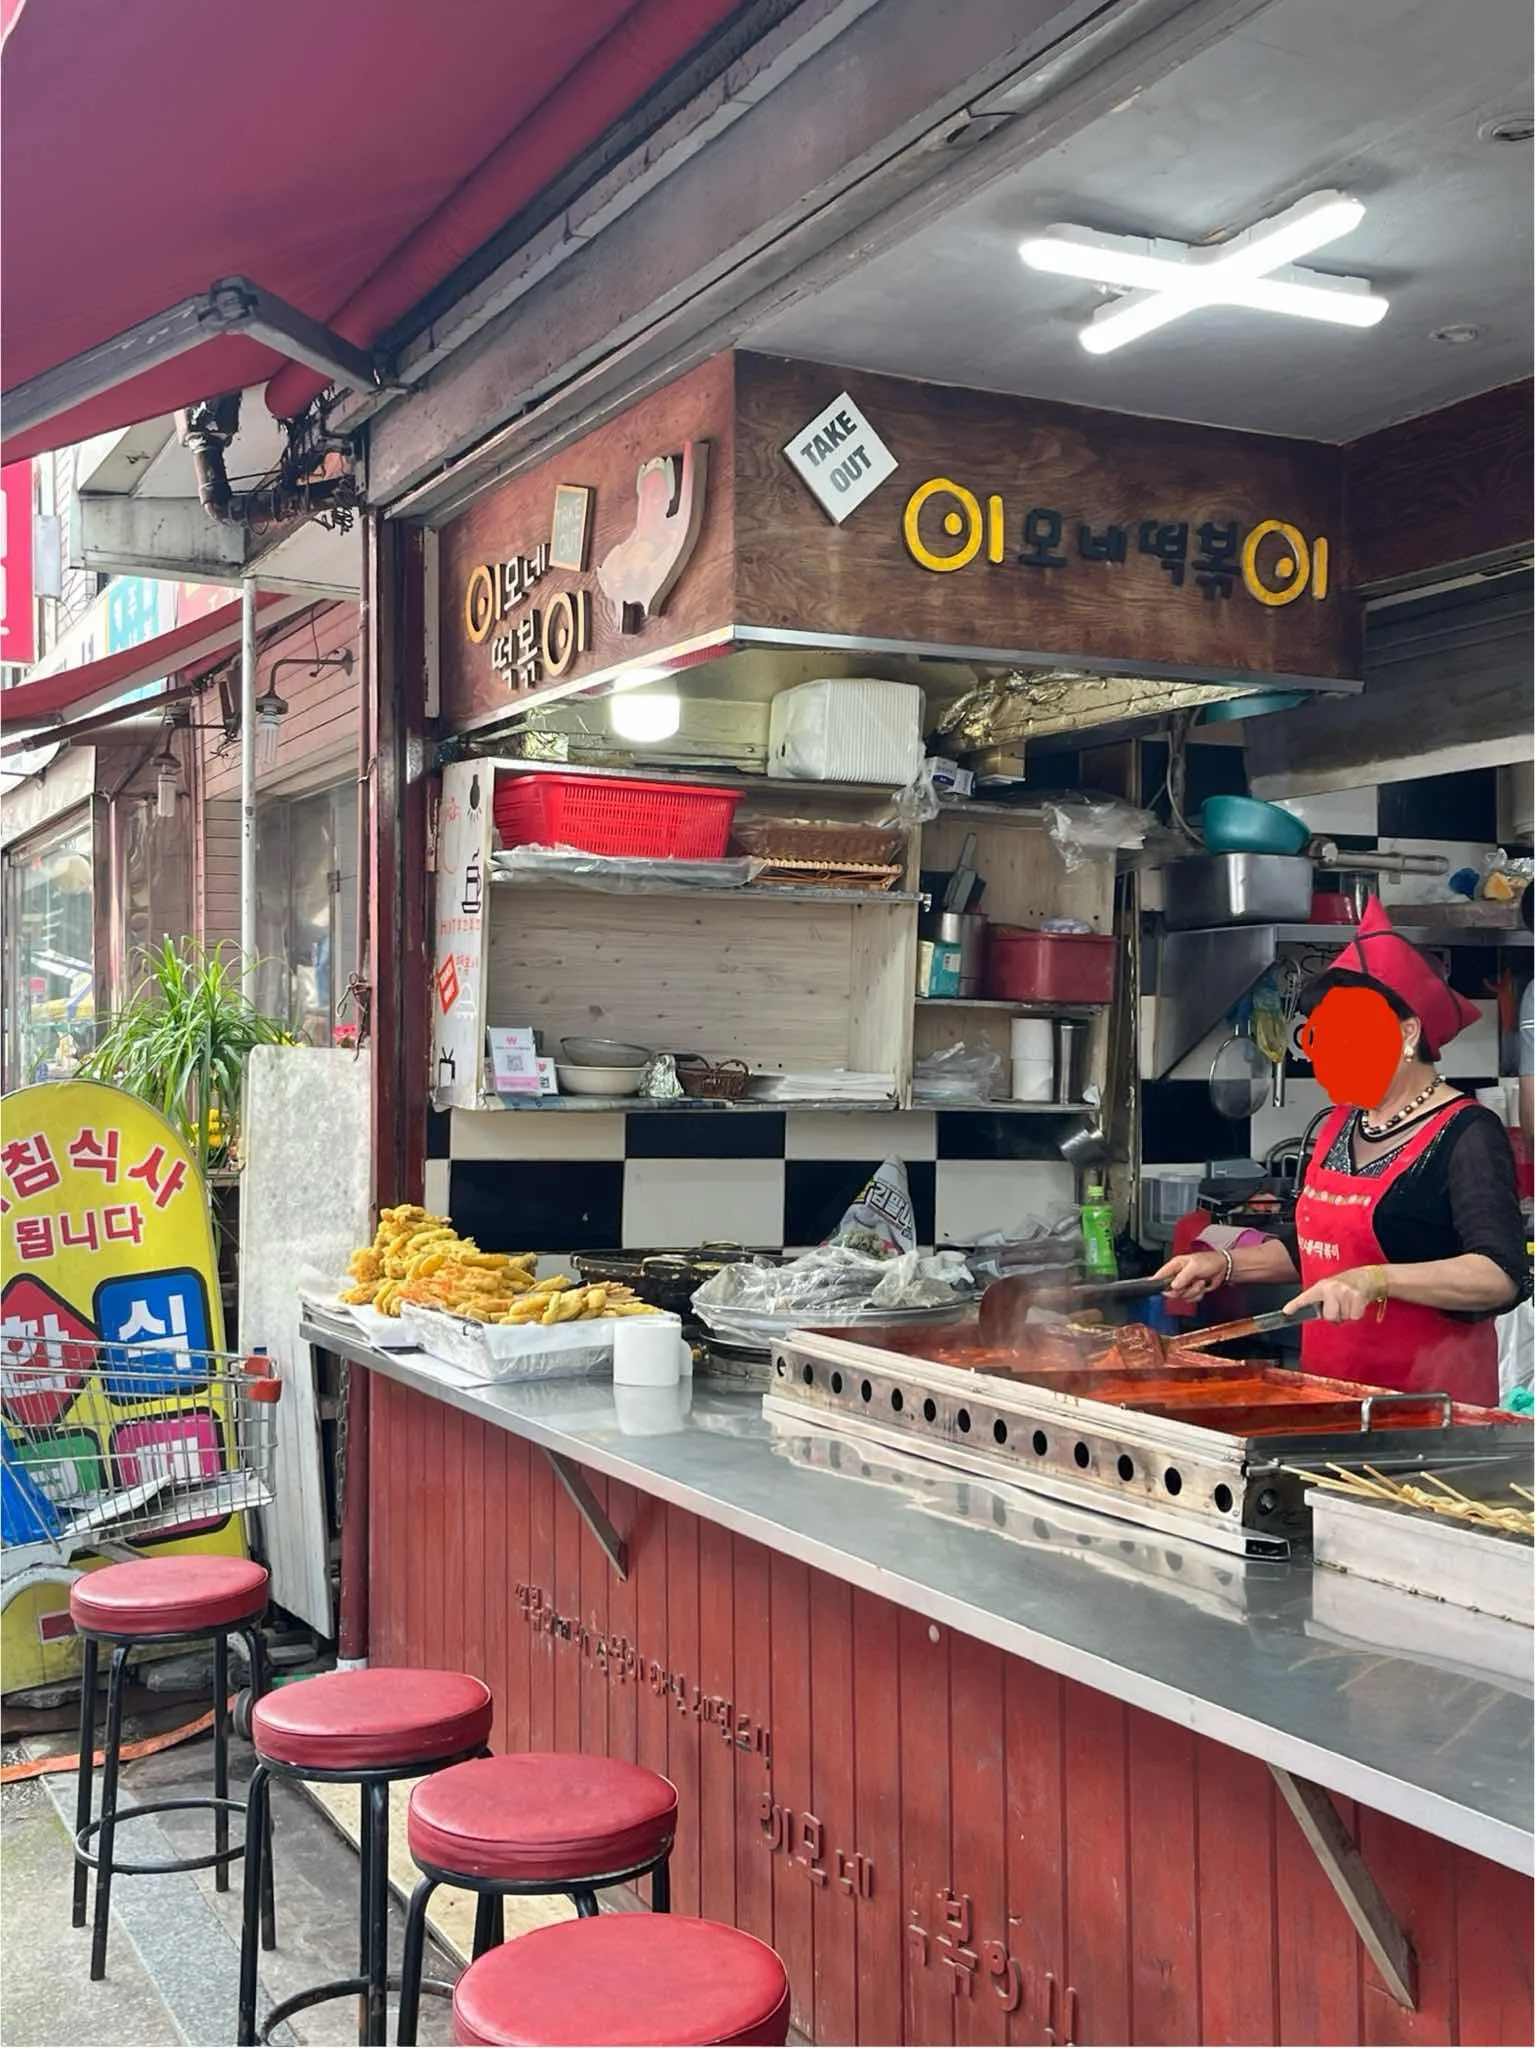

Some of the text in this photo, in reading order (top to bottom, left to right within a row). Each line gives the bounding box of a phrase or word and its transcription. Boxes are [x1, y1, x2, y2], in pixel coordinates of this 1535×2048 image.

[800, 409, 858, 468] TAKE
[829, 446, 875, 495] OUT
[492, 590, 591, 691] 떡볶이
[16, 1205, 143, 1260] 됩니다
